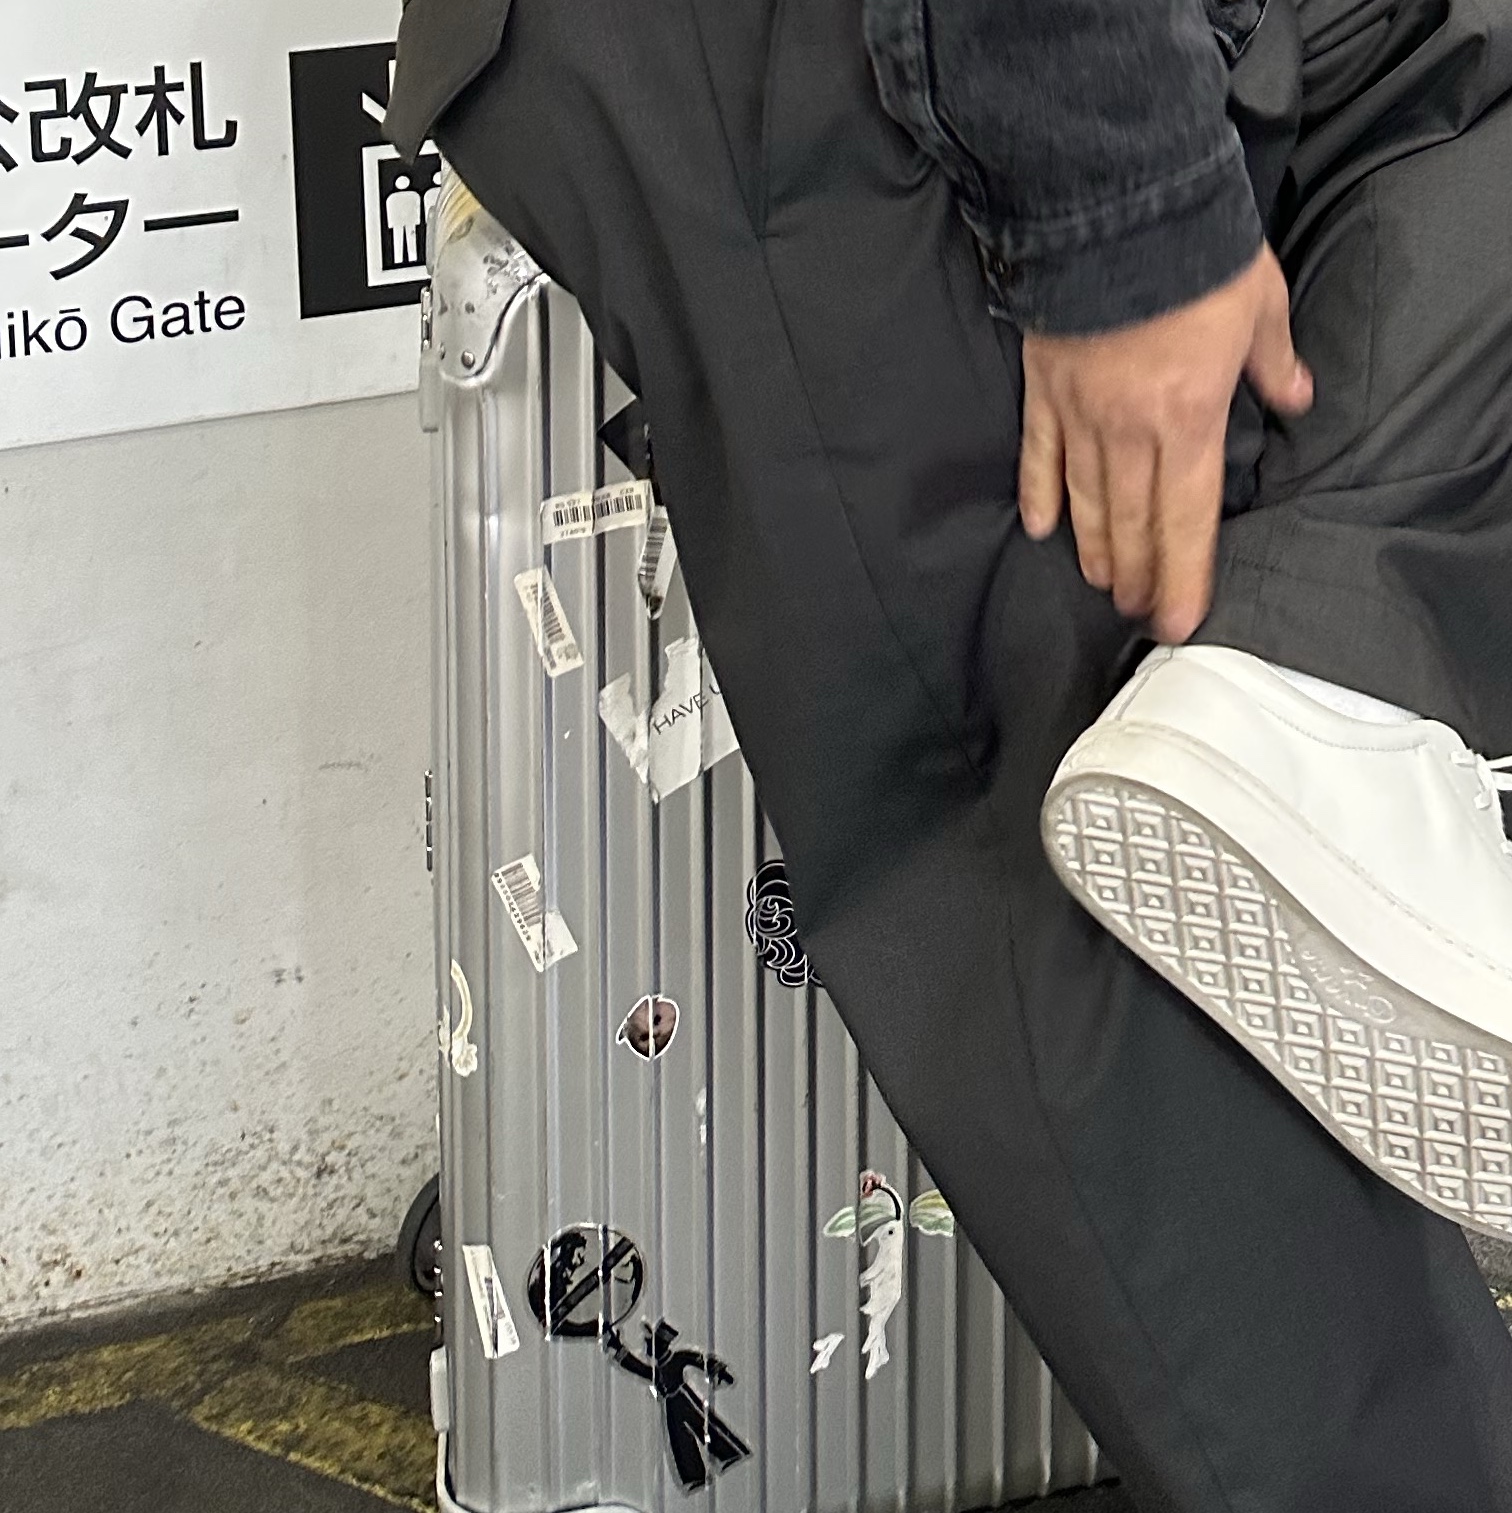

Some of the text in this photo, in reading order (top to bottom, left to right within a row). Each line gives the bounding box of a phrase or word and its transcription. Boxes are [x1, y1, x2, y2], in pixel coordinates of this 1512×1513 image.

[0, 61, 238, 172] 改札
[0, 290, 246, 359] ikō Gate
[653, 692, 710, 735] HAVE
